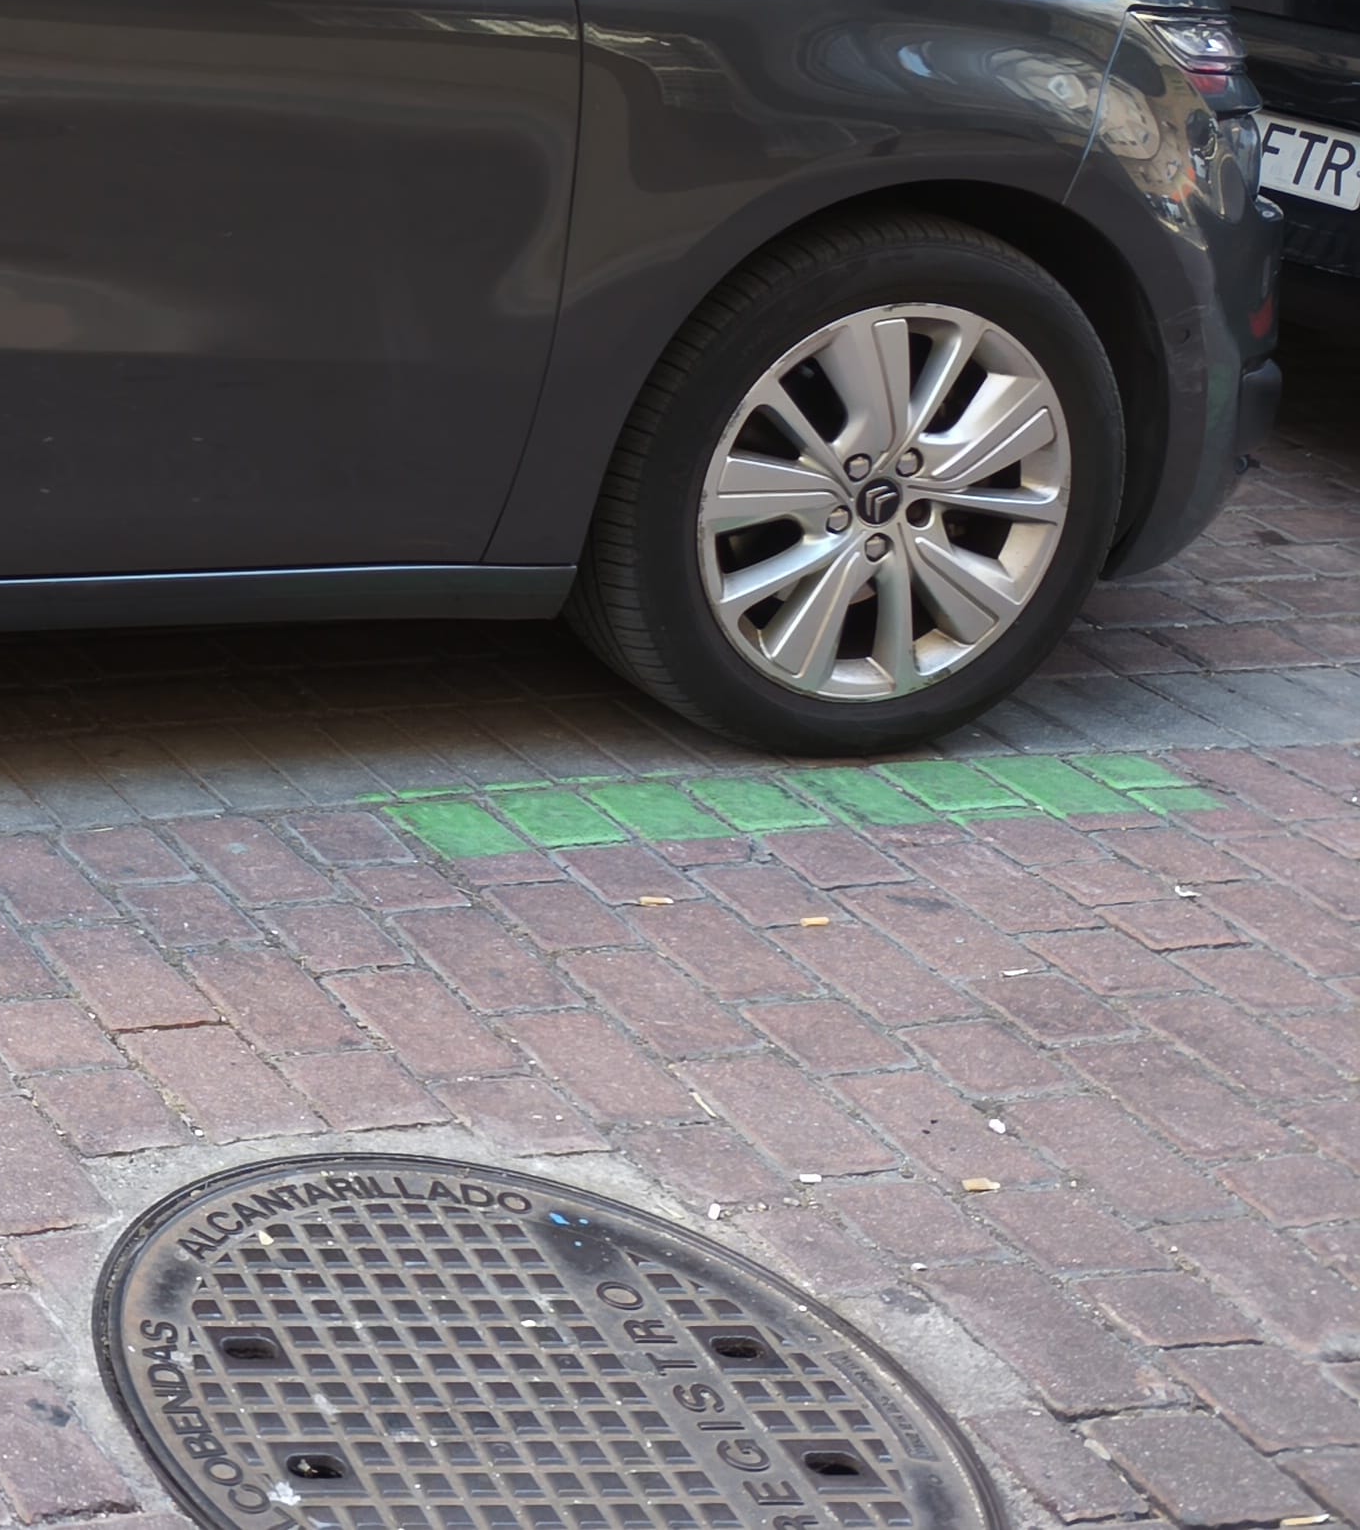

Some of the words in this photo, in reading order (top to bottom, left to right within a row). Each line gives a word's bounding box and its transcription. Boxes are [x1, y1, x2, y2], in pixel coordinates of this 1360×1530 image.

[1262, 123, 1356, 196] FTR
[176, 1176, 532, 1260] ALCANTARILLADO
[140, 1319, 306, 1530] LCOBENDAS
[596, 1281, 819, 1530] REGISTRO
